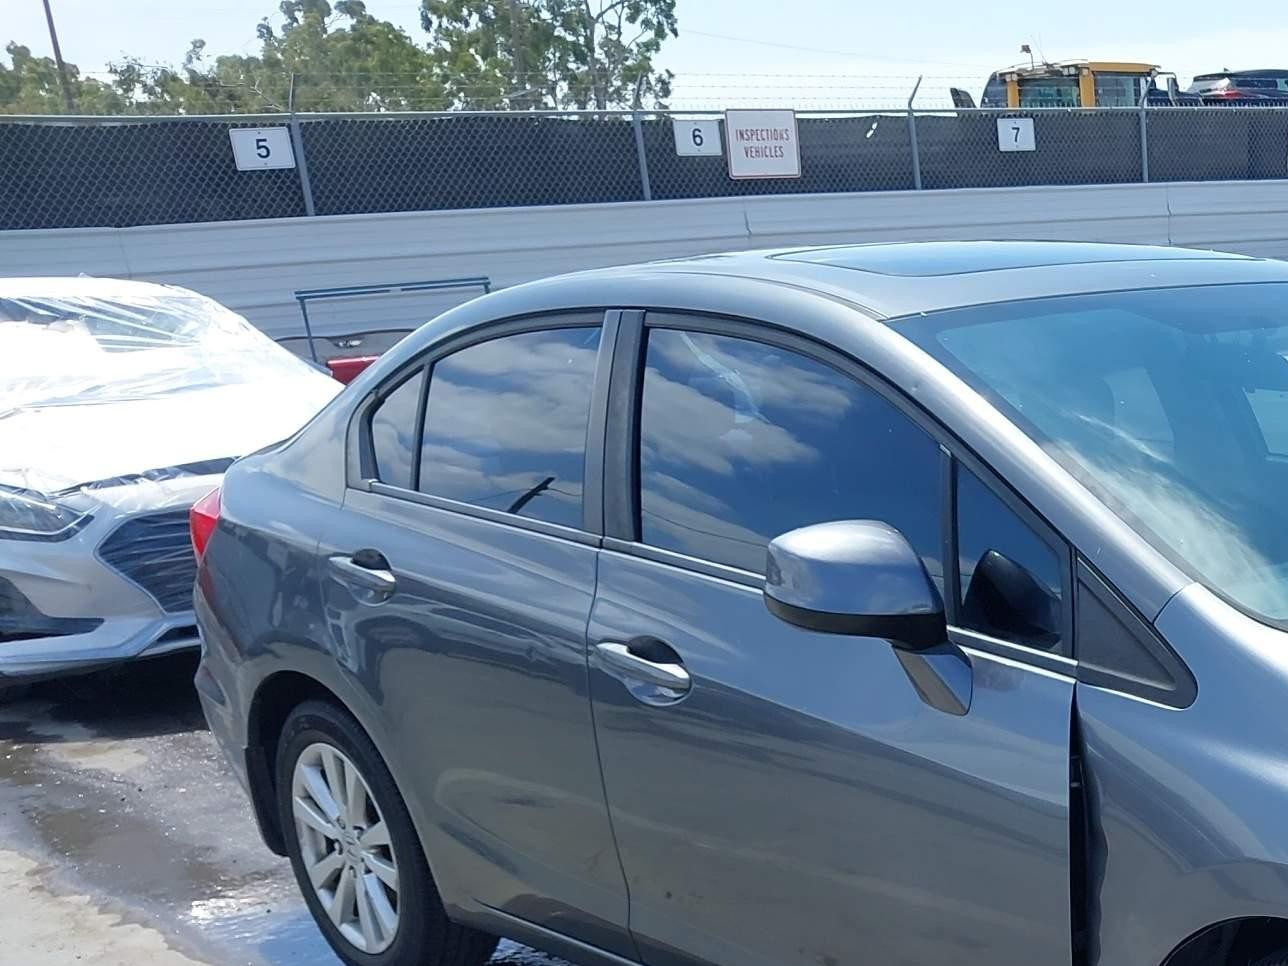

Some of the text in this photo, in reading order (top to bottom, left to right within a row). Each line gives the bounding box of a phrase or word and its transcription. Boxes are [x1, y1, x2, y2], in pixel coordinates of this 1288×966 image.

[692, 128, 704, 146] 6
[735, 128, 790, 142] INSPECTIONS
[1011, 127, 1020, 143] 7
[255, 138, 271, 159] 5
[743, 145, 785, 159] VEHICLES
